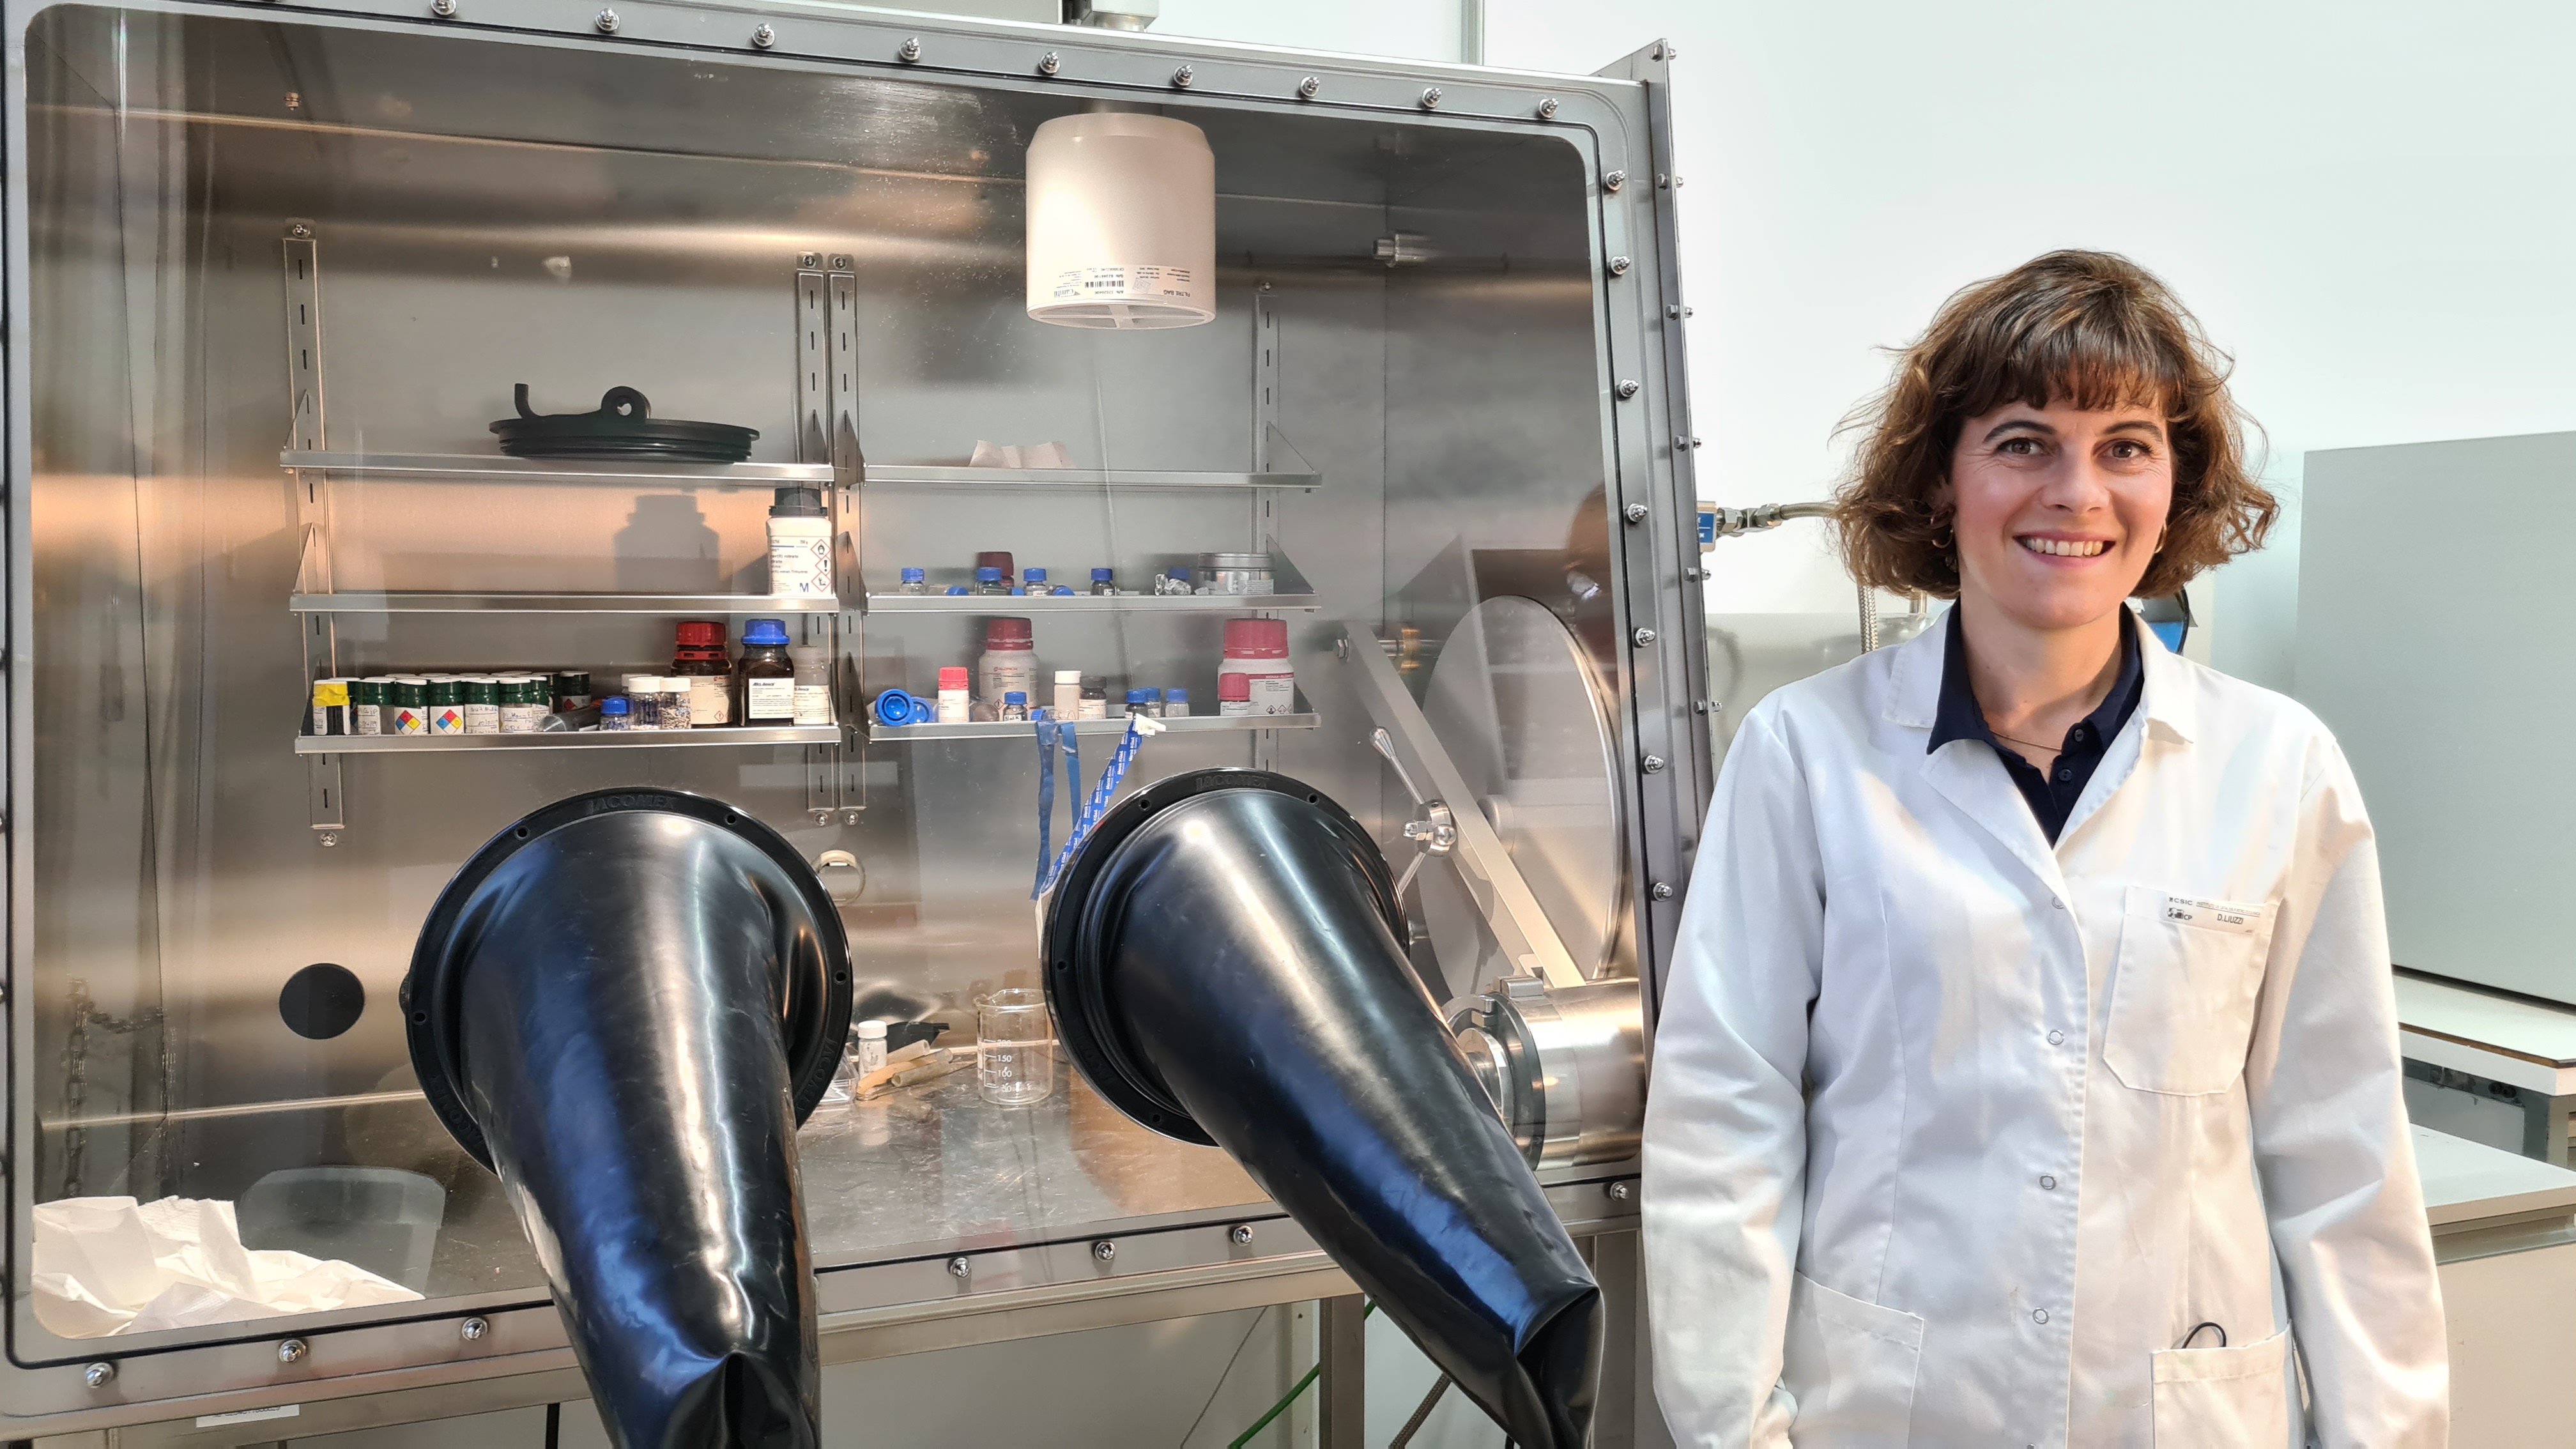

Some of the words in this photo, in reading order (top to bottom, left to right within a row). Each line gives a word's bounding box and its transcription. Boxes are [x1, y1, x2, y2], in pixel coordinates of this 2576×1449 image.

[799, 583, 809, 593] M
[2174, 898, 2193, 906] CSIC
[2217, 914, 2244, 925] D.LIUZZI
[997, 1054, 1013, 1062] 150
[998, 1070, 1013, 1078] 100
